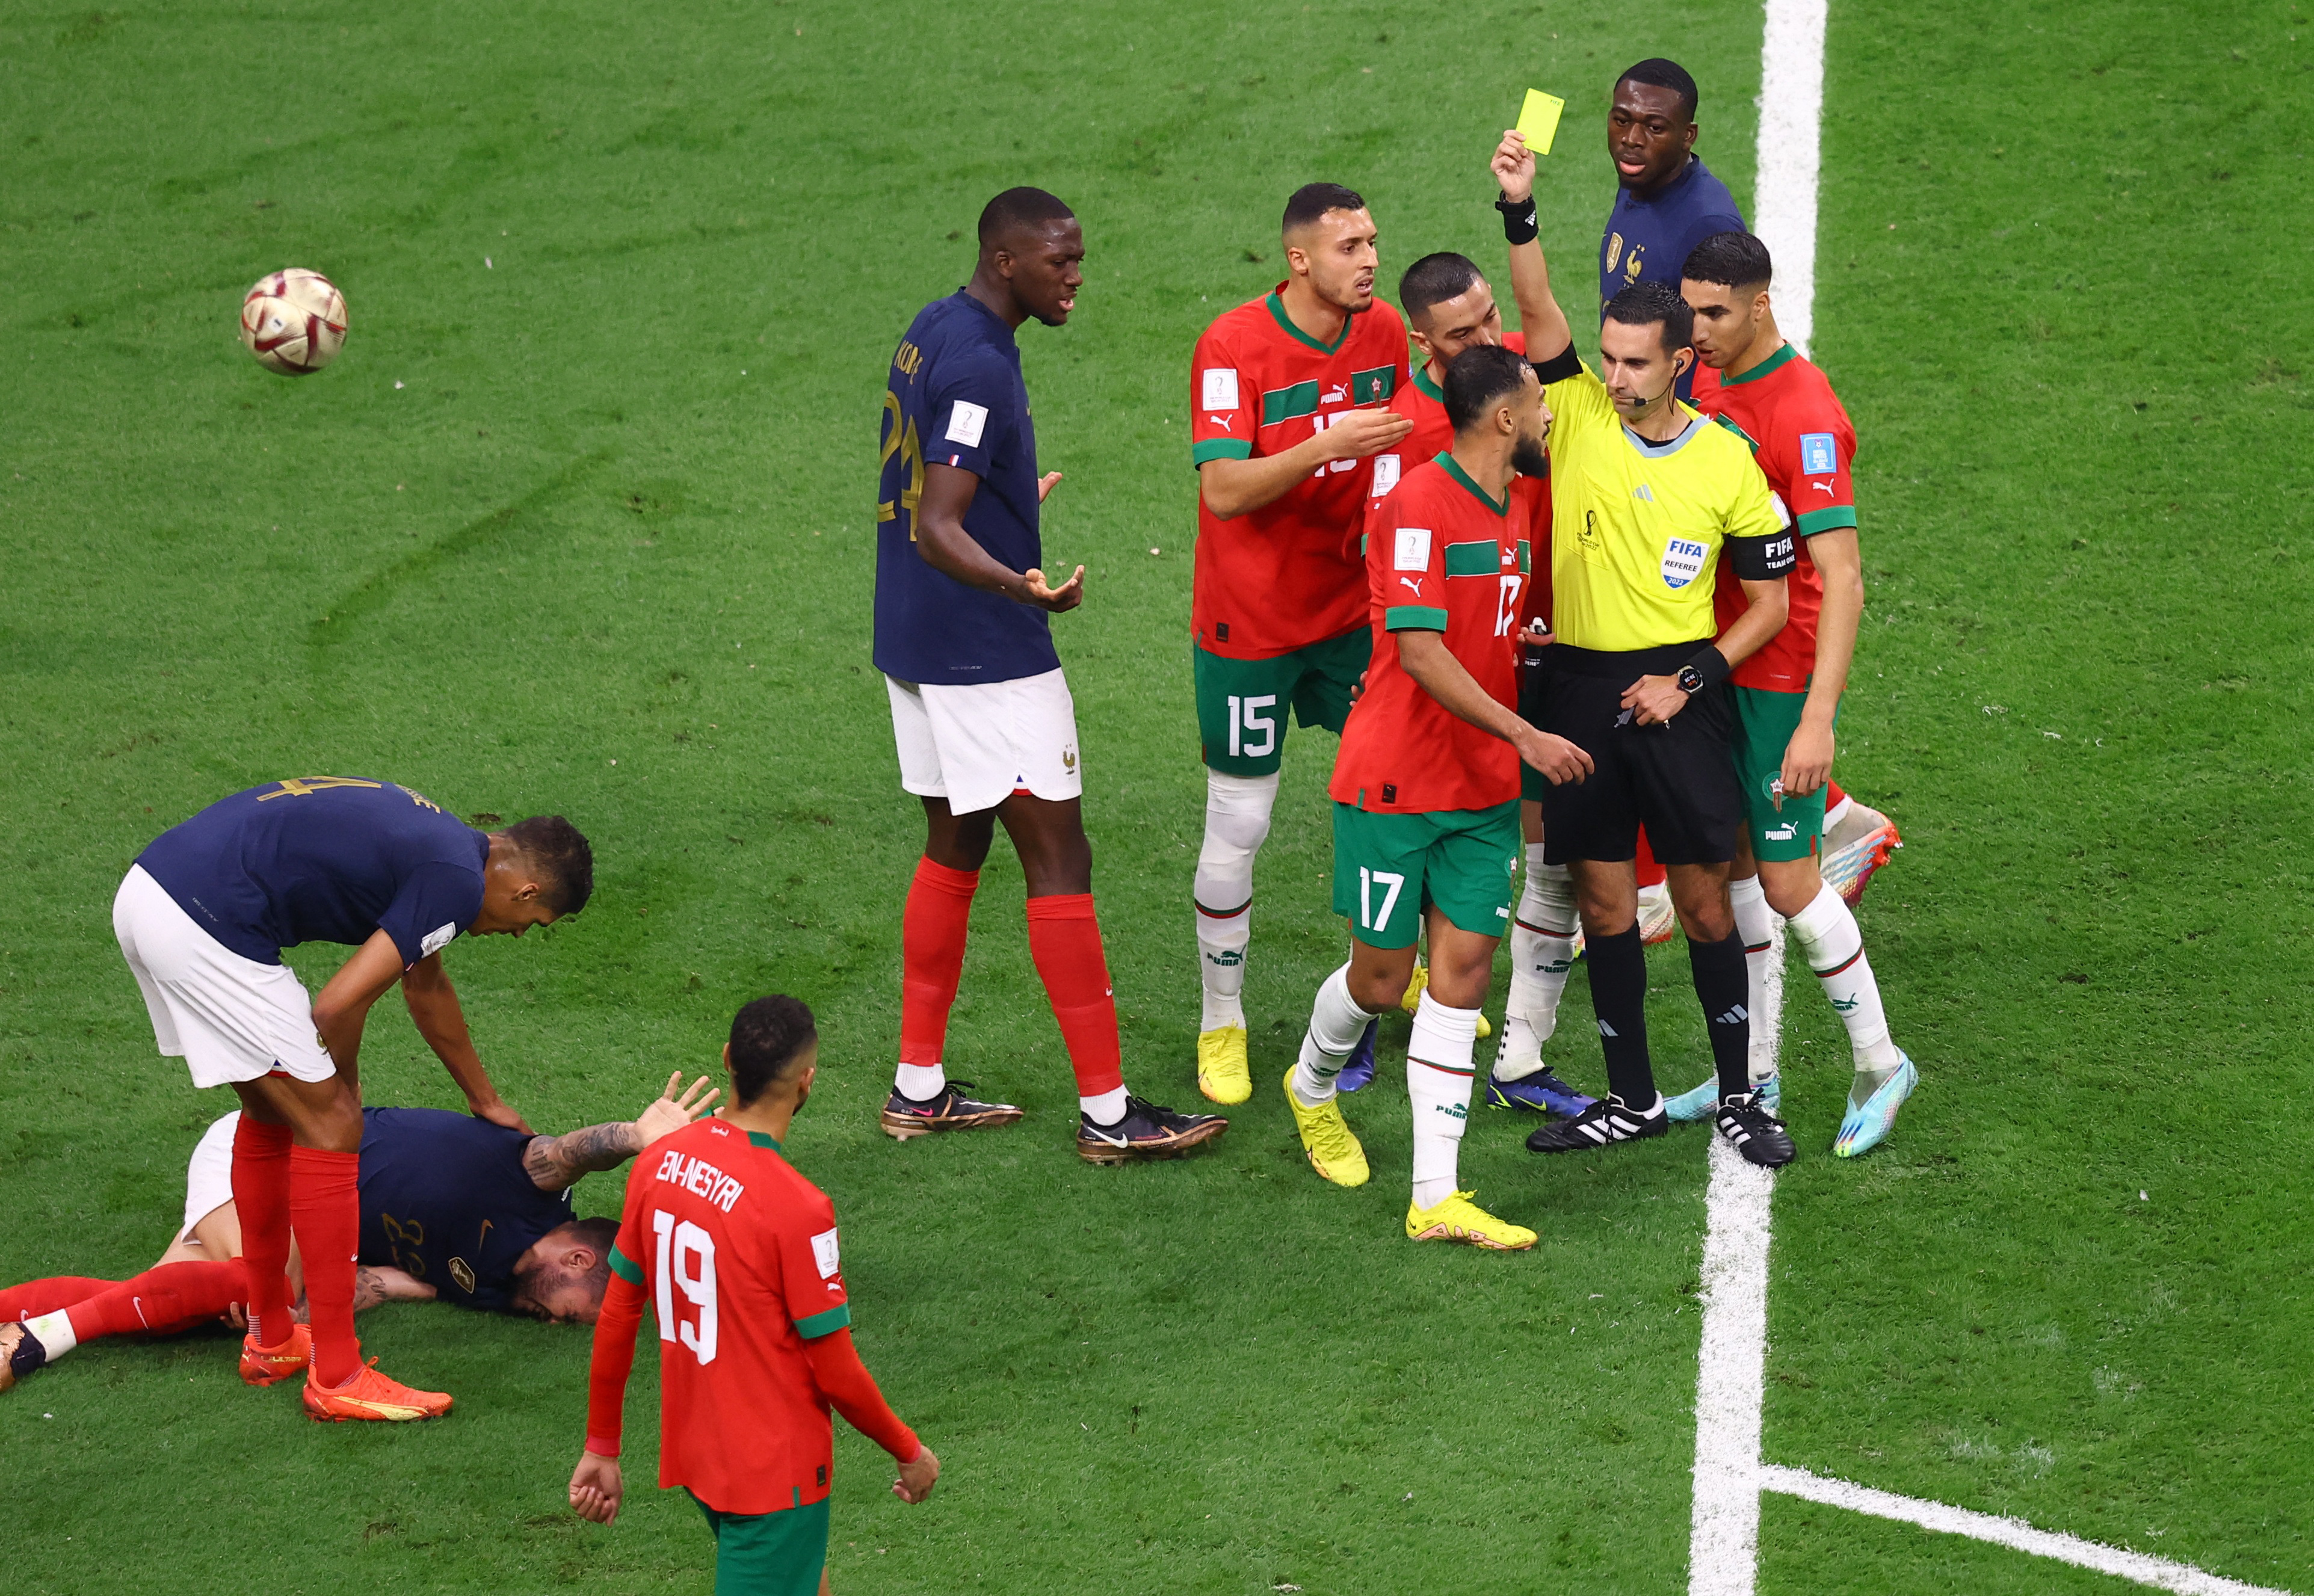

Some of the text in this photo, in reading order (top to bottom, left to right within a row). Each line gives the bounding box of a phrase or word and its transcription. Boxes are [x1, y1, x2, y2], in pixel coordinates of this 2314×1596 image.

[1321, 392, 1344, 405] PUMA
[878, 390, 925, 542] 24
[1670, 540, 1702, 558] FIFA
[1765, 537, 1793, 558] FIFA
[1665, 559, 1698, 572] REFEREE
[1766, 554, 1795, 569] TEAM ONE
[1495, 575, 1522, 636] 17
[1228, 694, 1276, 757] 15
[1765, 831, 1792, 840] PUMA
[1360, 866, 1405, 932] 17
[1208, 952, 1239, 966] PUMA
[1536, 964, 1569, 973] PUMA
[656, 1150, 745, 1213] EN-NESYRI
[653, 1209, 718, 1366] 19
